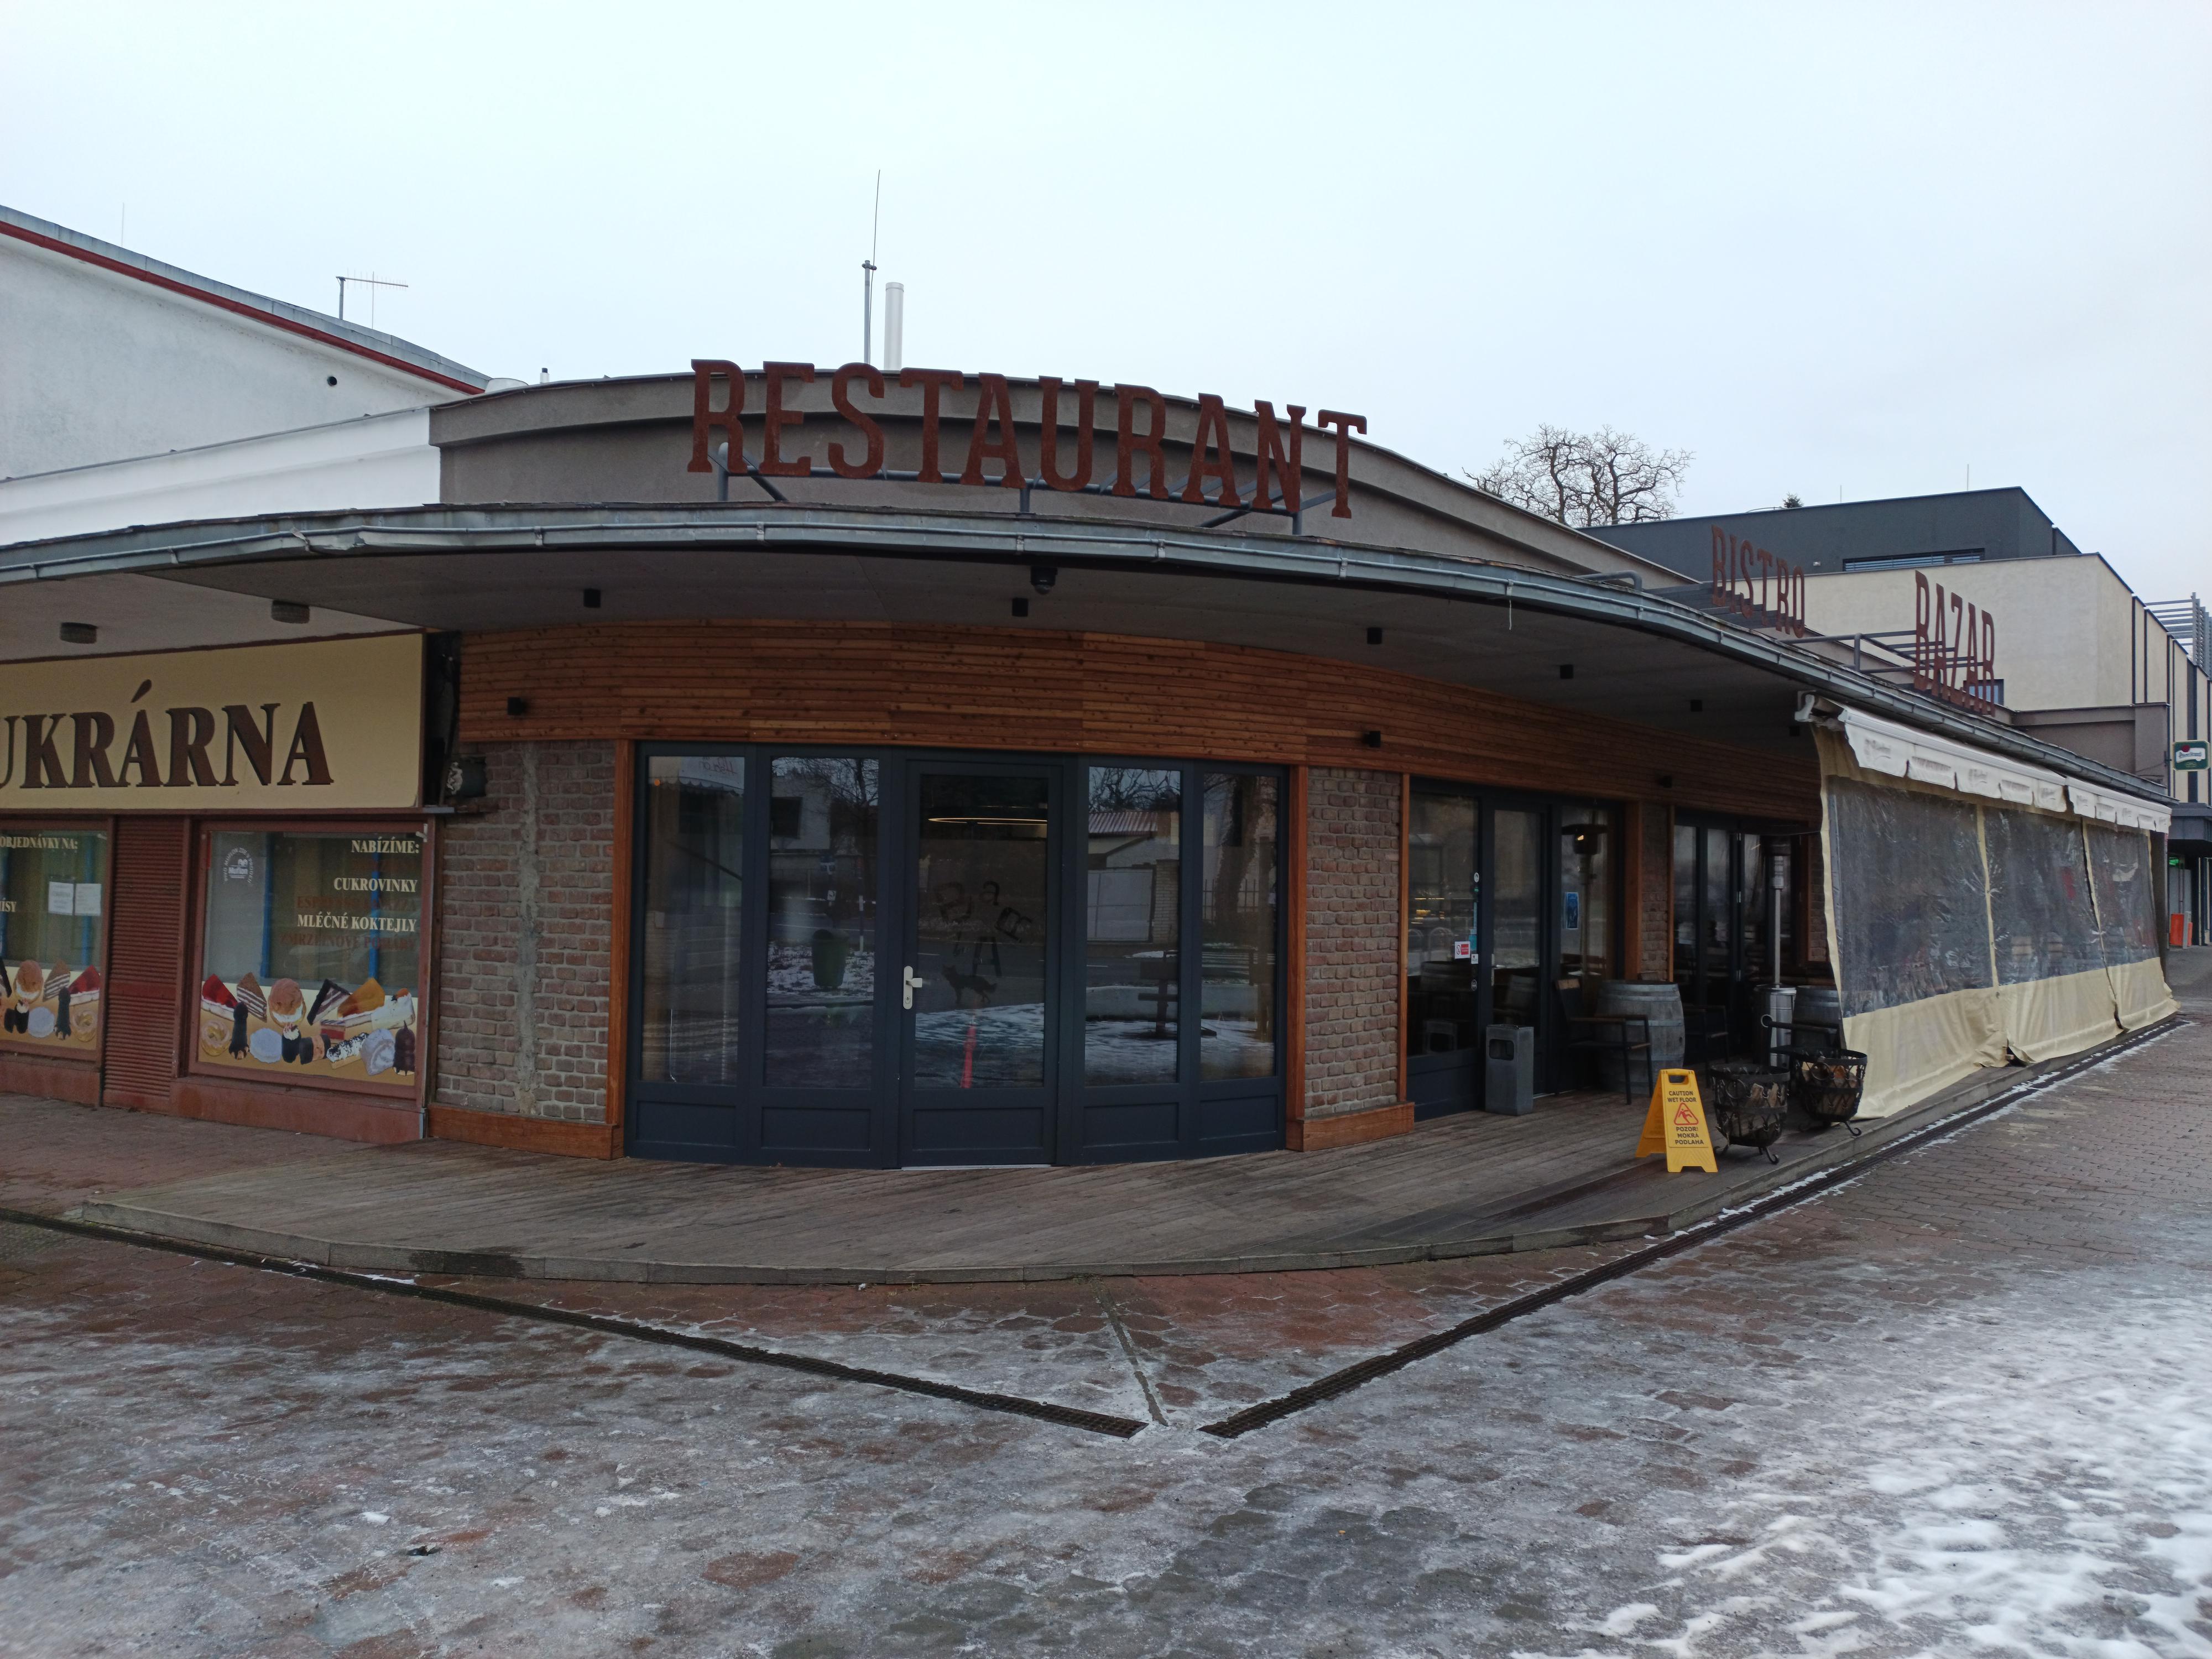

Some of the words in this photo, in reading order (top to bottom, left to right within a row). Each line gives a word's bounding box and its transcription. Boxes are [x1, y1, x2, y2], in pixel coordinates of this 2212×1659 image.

[687, 359, 1367, 519] RESTAURANT
[1711, 524, 1806, 638] BISTRO
[1913, 570, 1996, 717] BAZAR
[62, 838, 78, 849] NA:
[351, 836, 420, 854] NABÍZÍME:
[333, 877, 418, 893] CUKROVINKY
[297, 911, 348, 929] MLÉČNÉ
[351, 916, 417, 932] KOKTEJLY
